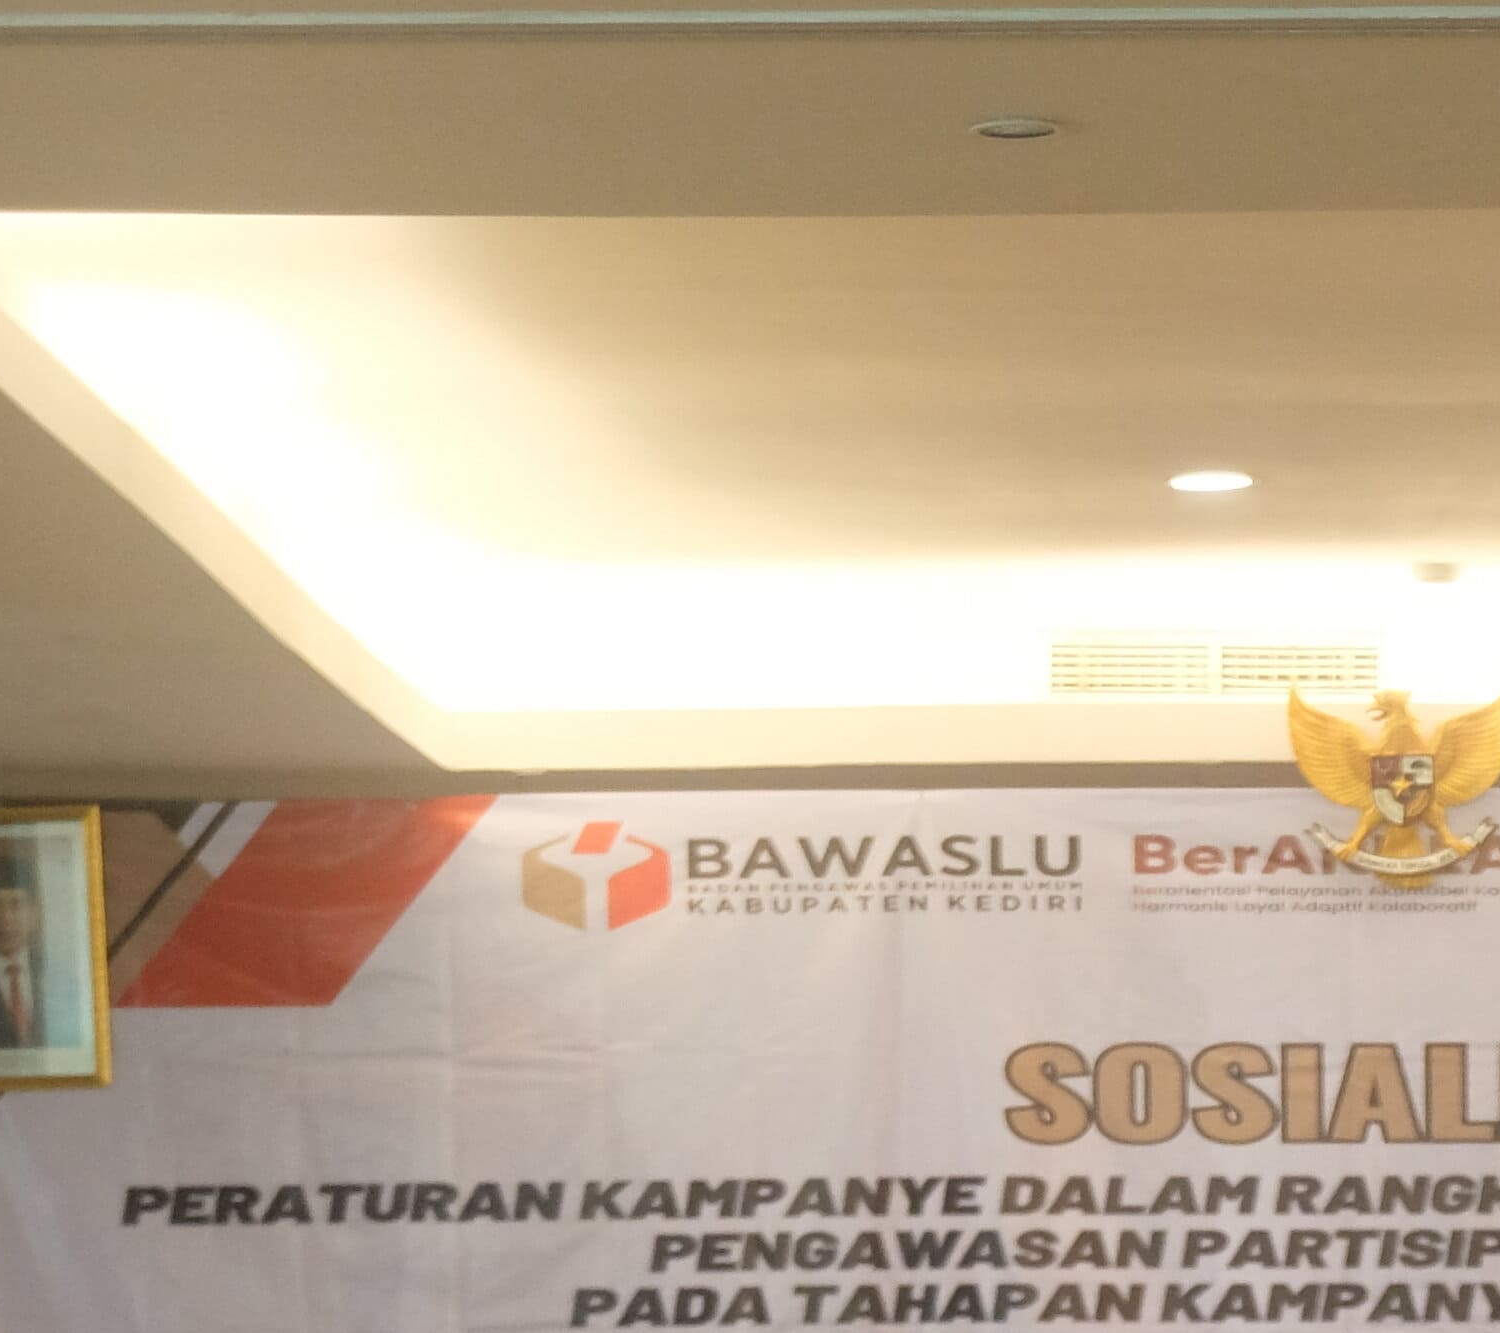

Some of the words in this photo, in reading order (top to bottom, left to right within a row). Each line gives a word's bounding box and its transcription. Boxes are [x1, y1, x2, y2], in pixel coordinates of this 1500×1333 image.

[687, 834, 1082, 879] BAWASLU
[687, 894, 928, 914] KABUPATEN
[948, 893, 1083, 912] KEDIRI
[121, 1181, 565, 1227] PERATURAN
[579, 1175, 986, 1220] KAMPANYE
[999, 1175, 1260, 1216] DALAM
[649, 1228, 1167, 1273] PENGAWASAN
[569, 1286, 771, 1328] PADA
[793, 1282, 1147, 1325] TAHAPAN
